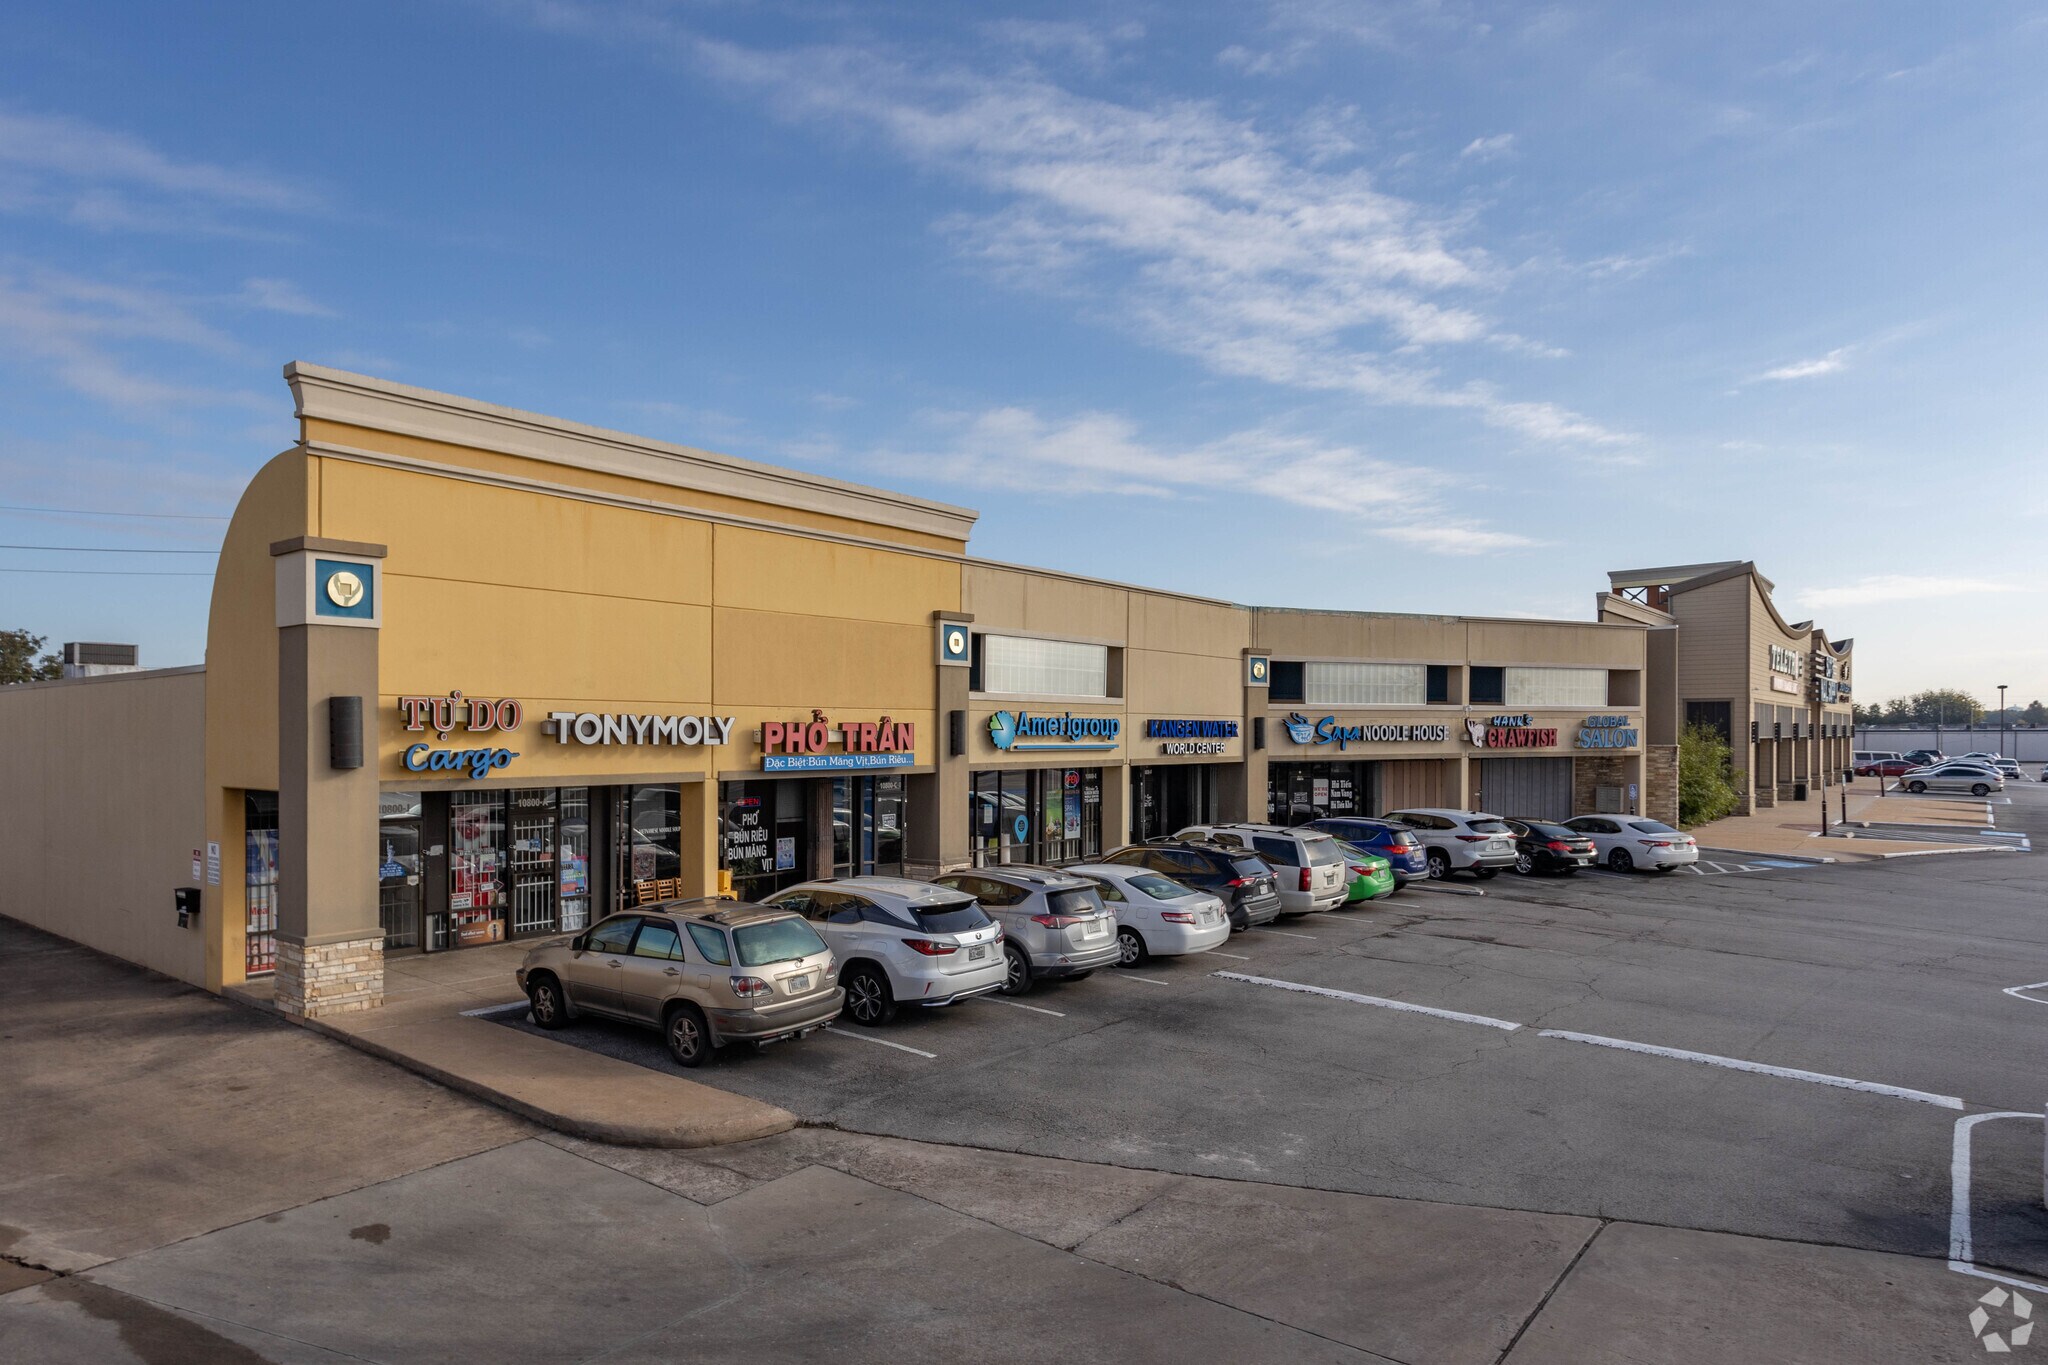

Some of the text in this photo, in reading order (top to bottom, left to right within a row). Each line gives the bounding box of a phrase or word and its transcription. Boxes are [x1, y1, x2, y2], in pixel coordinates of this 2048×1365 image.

[401, 690, 523, 740] TỰ DO
[1587, 715, 1631, 728] GLOBAL
[551, 712, 736, 745] TONYMOLY
[764, 709, 915, 753] PHỞ TRÂN
[1017, 711, 1121, 742] Amerigroup
[1149, 719, 1239, 738] KANGEN WATER
[1314, 715, 1450, 751] Sapa NOODLE HOUSE
[1488, 728, 1558, 748] CRAWFISH
[1580, 728, 1638, 748] SALON
[1167, 742, 1226, 754] WORLD CENTER
[405, 743, 520, 780] Cargo
[765, 757, 786, 769] Đặc
[737, 797, 760, 806] OPEN
[733, 826, 768, 843] BÚN RIÊU
[728, 845, 744, 860] BÚN
[745, 843, 767, 858] MĂNG
[761, 858, 774, 872] VỊT
